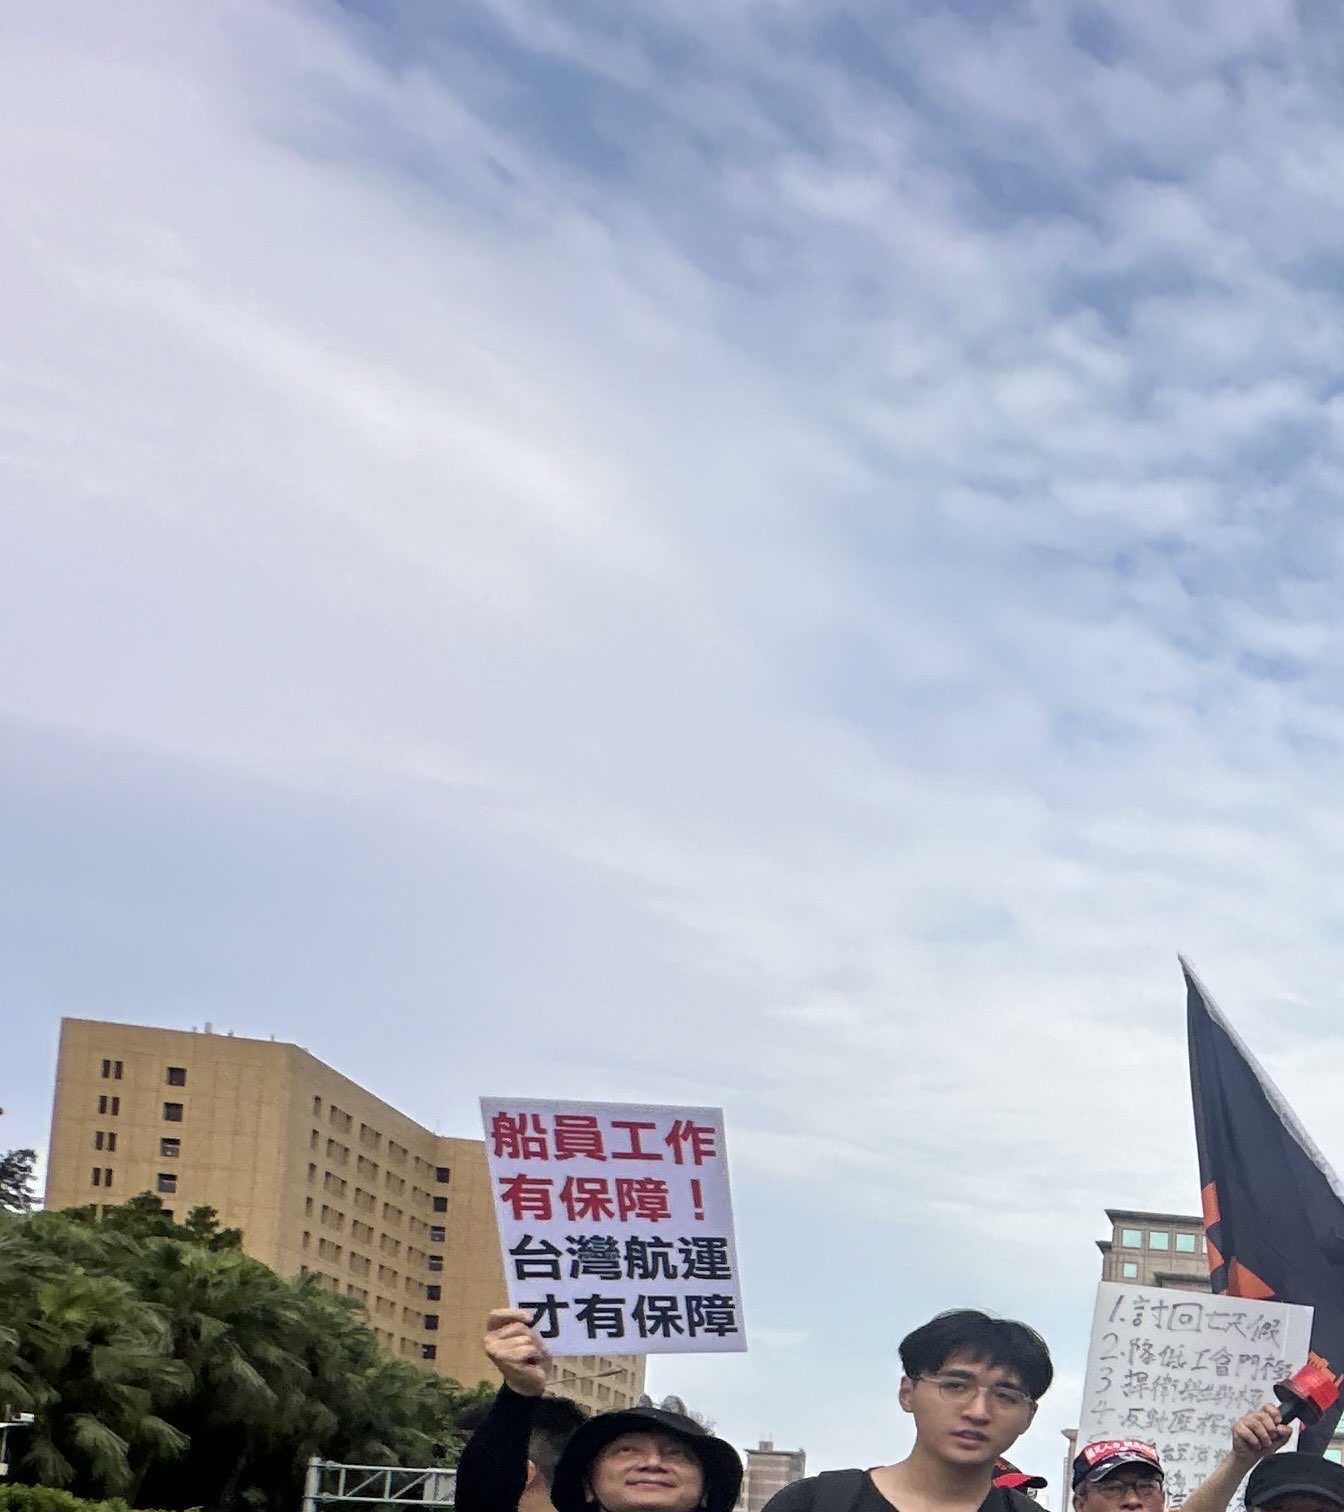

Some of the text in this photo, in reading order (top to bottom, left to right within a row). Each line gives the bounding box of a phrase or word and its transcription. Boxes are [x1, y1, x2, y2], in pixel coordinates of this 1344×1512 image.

[490, 1111, 716, 1165] 船員工作
[500, 1174, 705, 1222] 有保障！
[509, 1234, 732, 1280] 台灣航運
[518, 1293, 739, 1338] 才有保障
